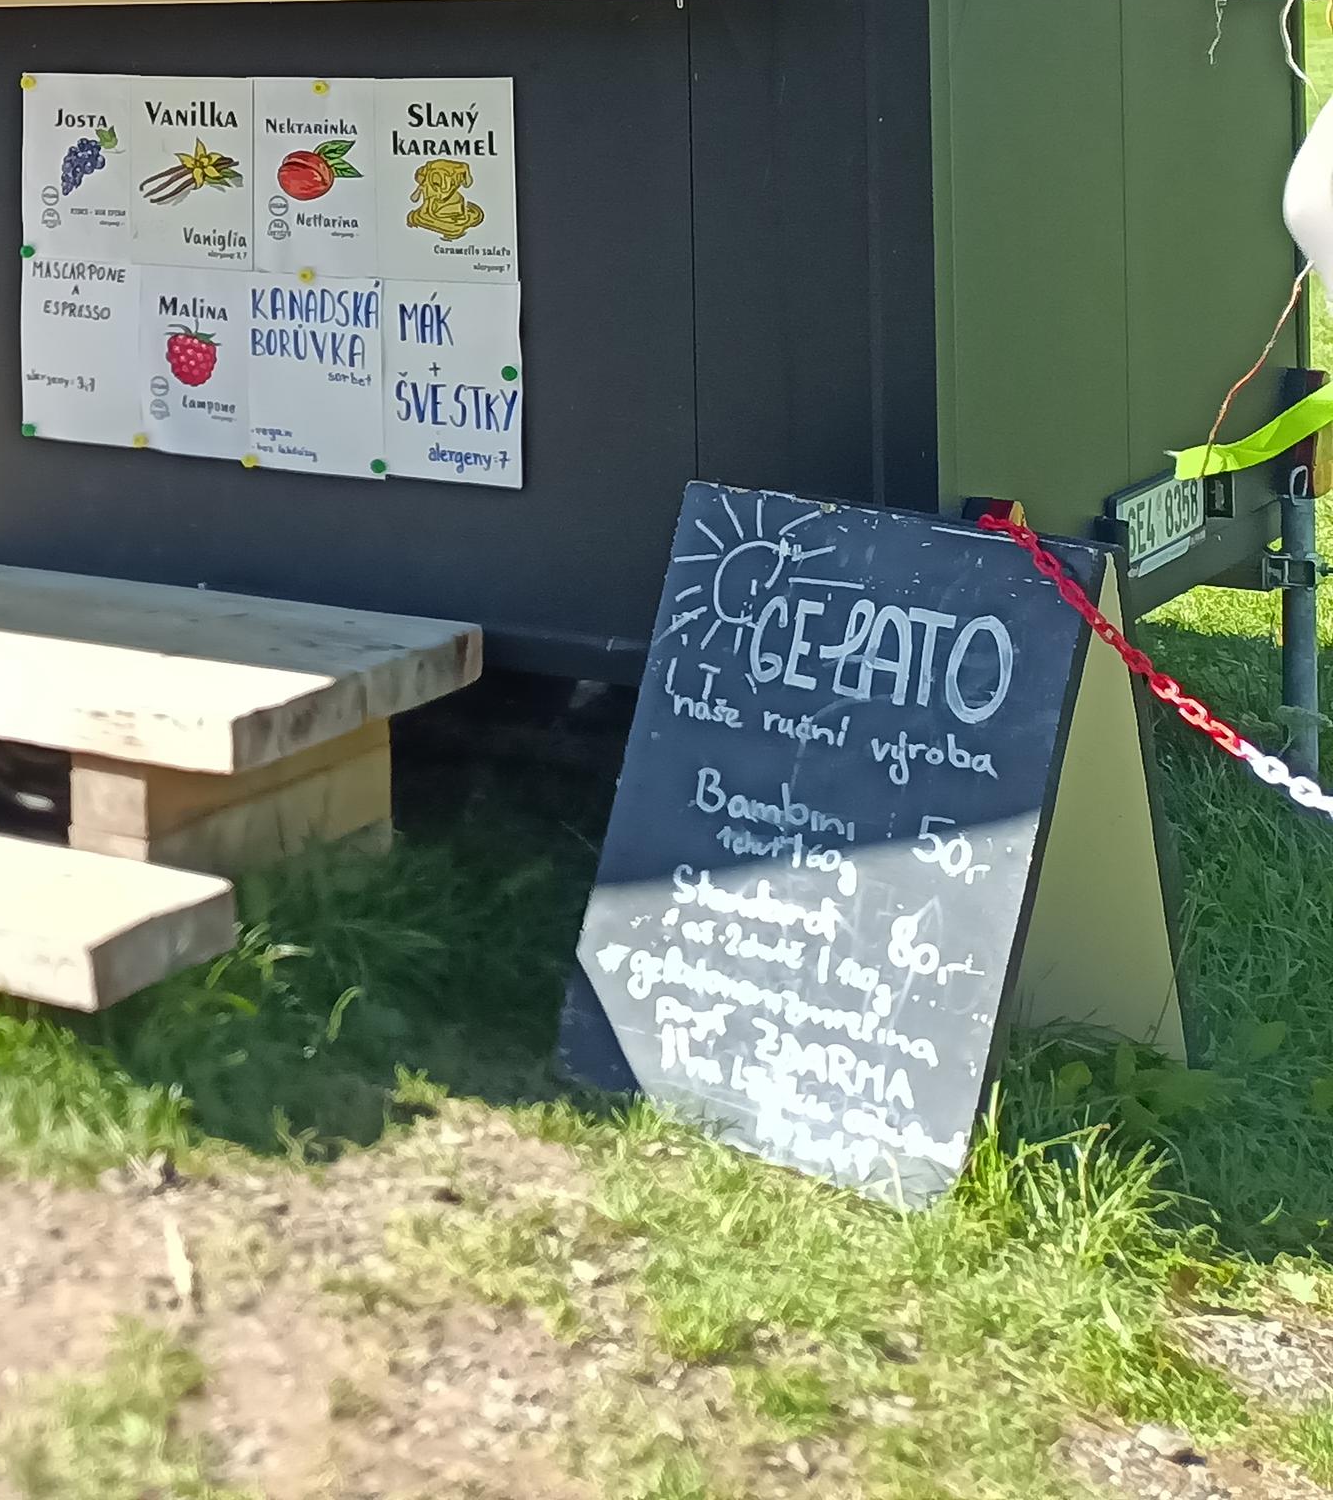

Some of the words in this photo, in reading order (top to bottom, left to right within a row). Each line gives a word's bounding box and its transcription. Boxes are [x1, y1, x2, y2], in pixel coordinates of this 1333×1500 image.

[183, 227, 248, 252] Vaniglia
[433, 244, 481, 257] Caramello
[32, 260, 127, 284] MASCARPONE
[71, 284, 81, 296] A
[43, 299, 112, 321] ESPRESSO
[251, 279, 382, 330] KANADSKÁ
[399, 291, 455, 347] MÁK
[251, 323, 366, 370] BORŮVKA
[327, 371, 372, 387] sorbet
[395, 370, 519, 434] ŠVESTKY
[1164, 479, 1198, 538] 8358
[673, 693, 744, 729] naše
[762, 711, 851, 748] ruční
[870, 730, 1000, 786] výroba
